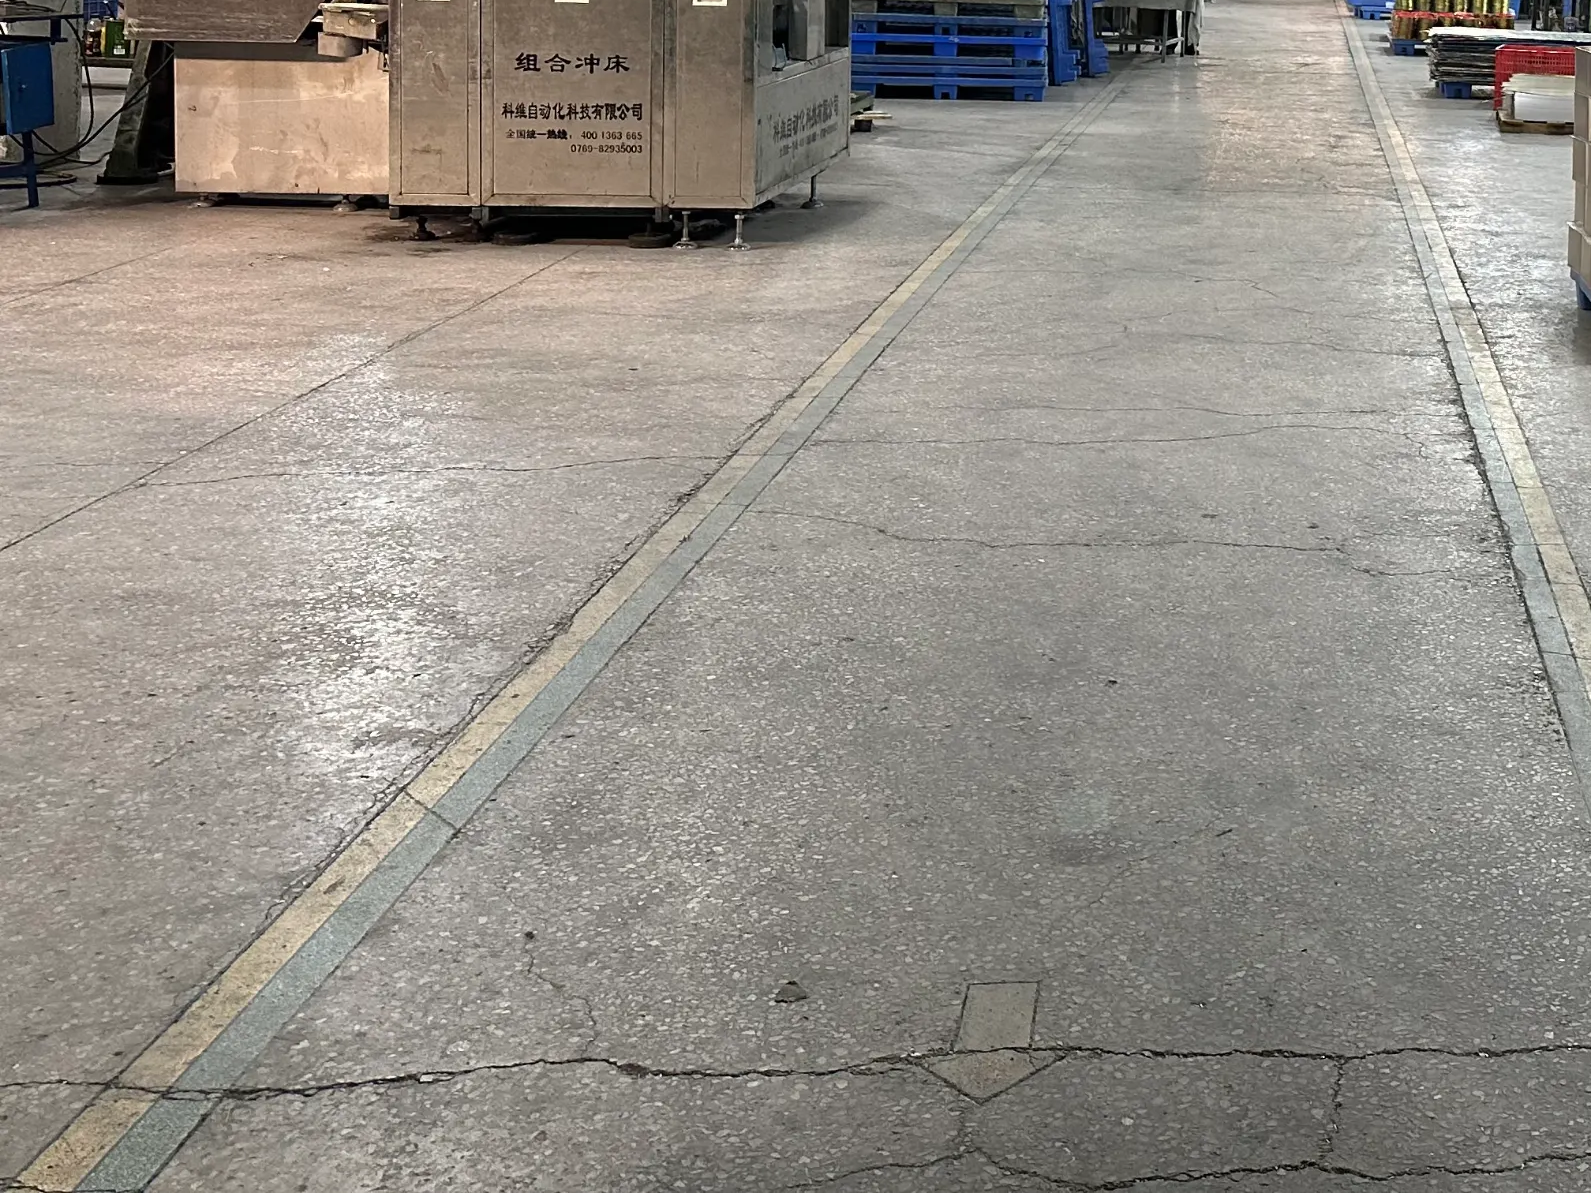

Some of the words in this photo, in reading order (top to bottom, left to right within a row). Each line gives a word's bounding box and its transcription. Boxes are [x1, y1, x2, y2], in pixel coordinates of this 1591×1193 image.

[514, 52, 630, 75] 组合冲床
[501, 102, 643, 122] 科维自动化科技有限公司
[581, 130, 598, 140] 400
